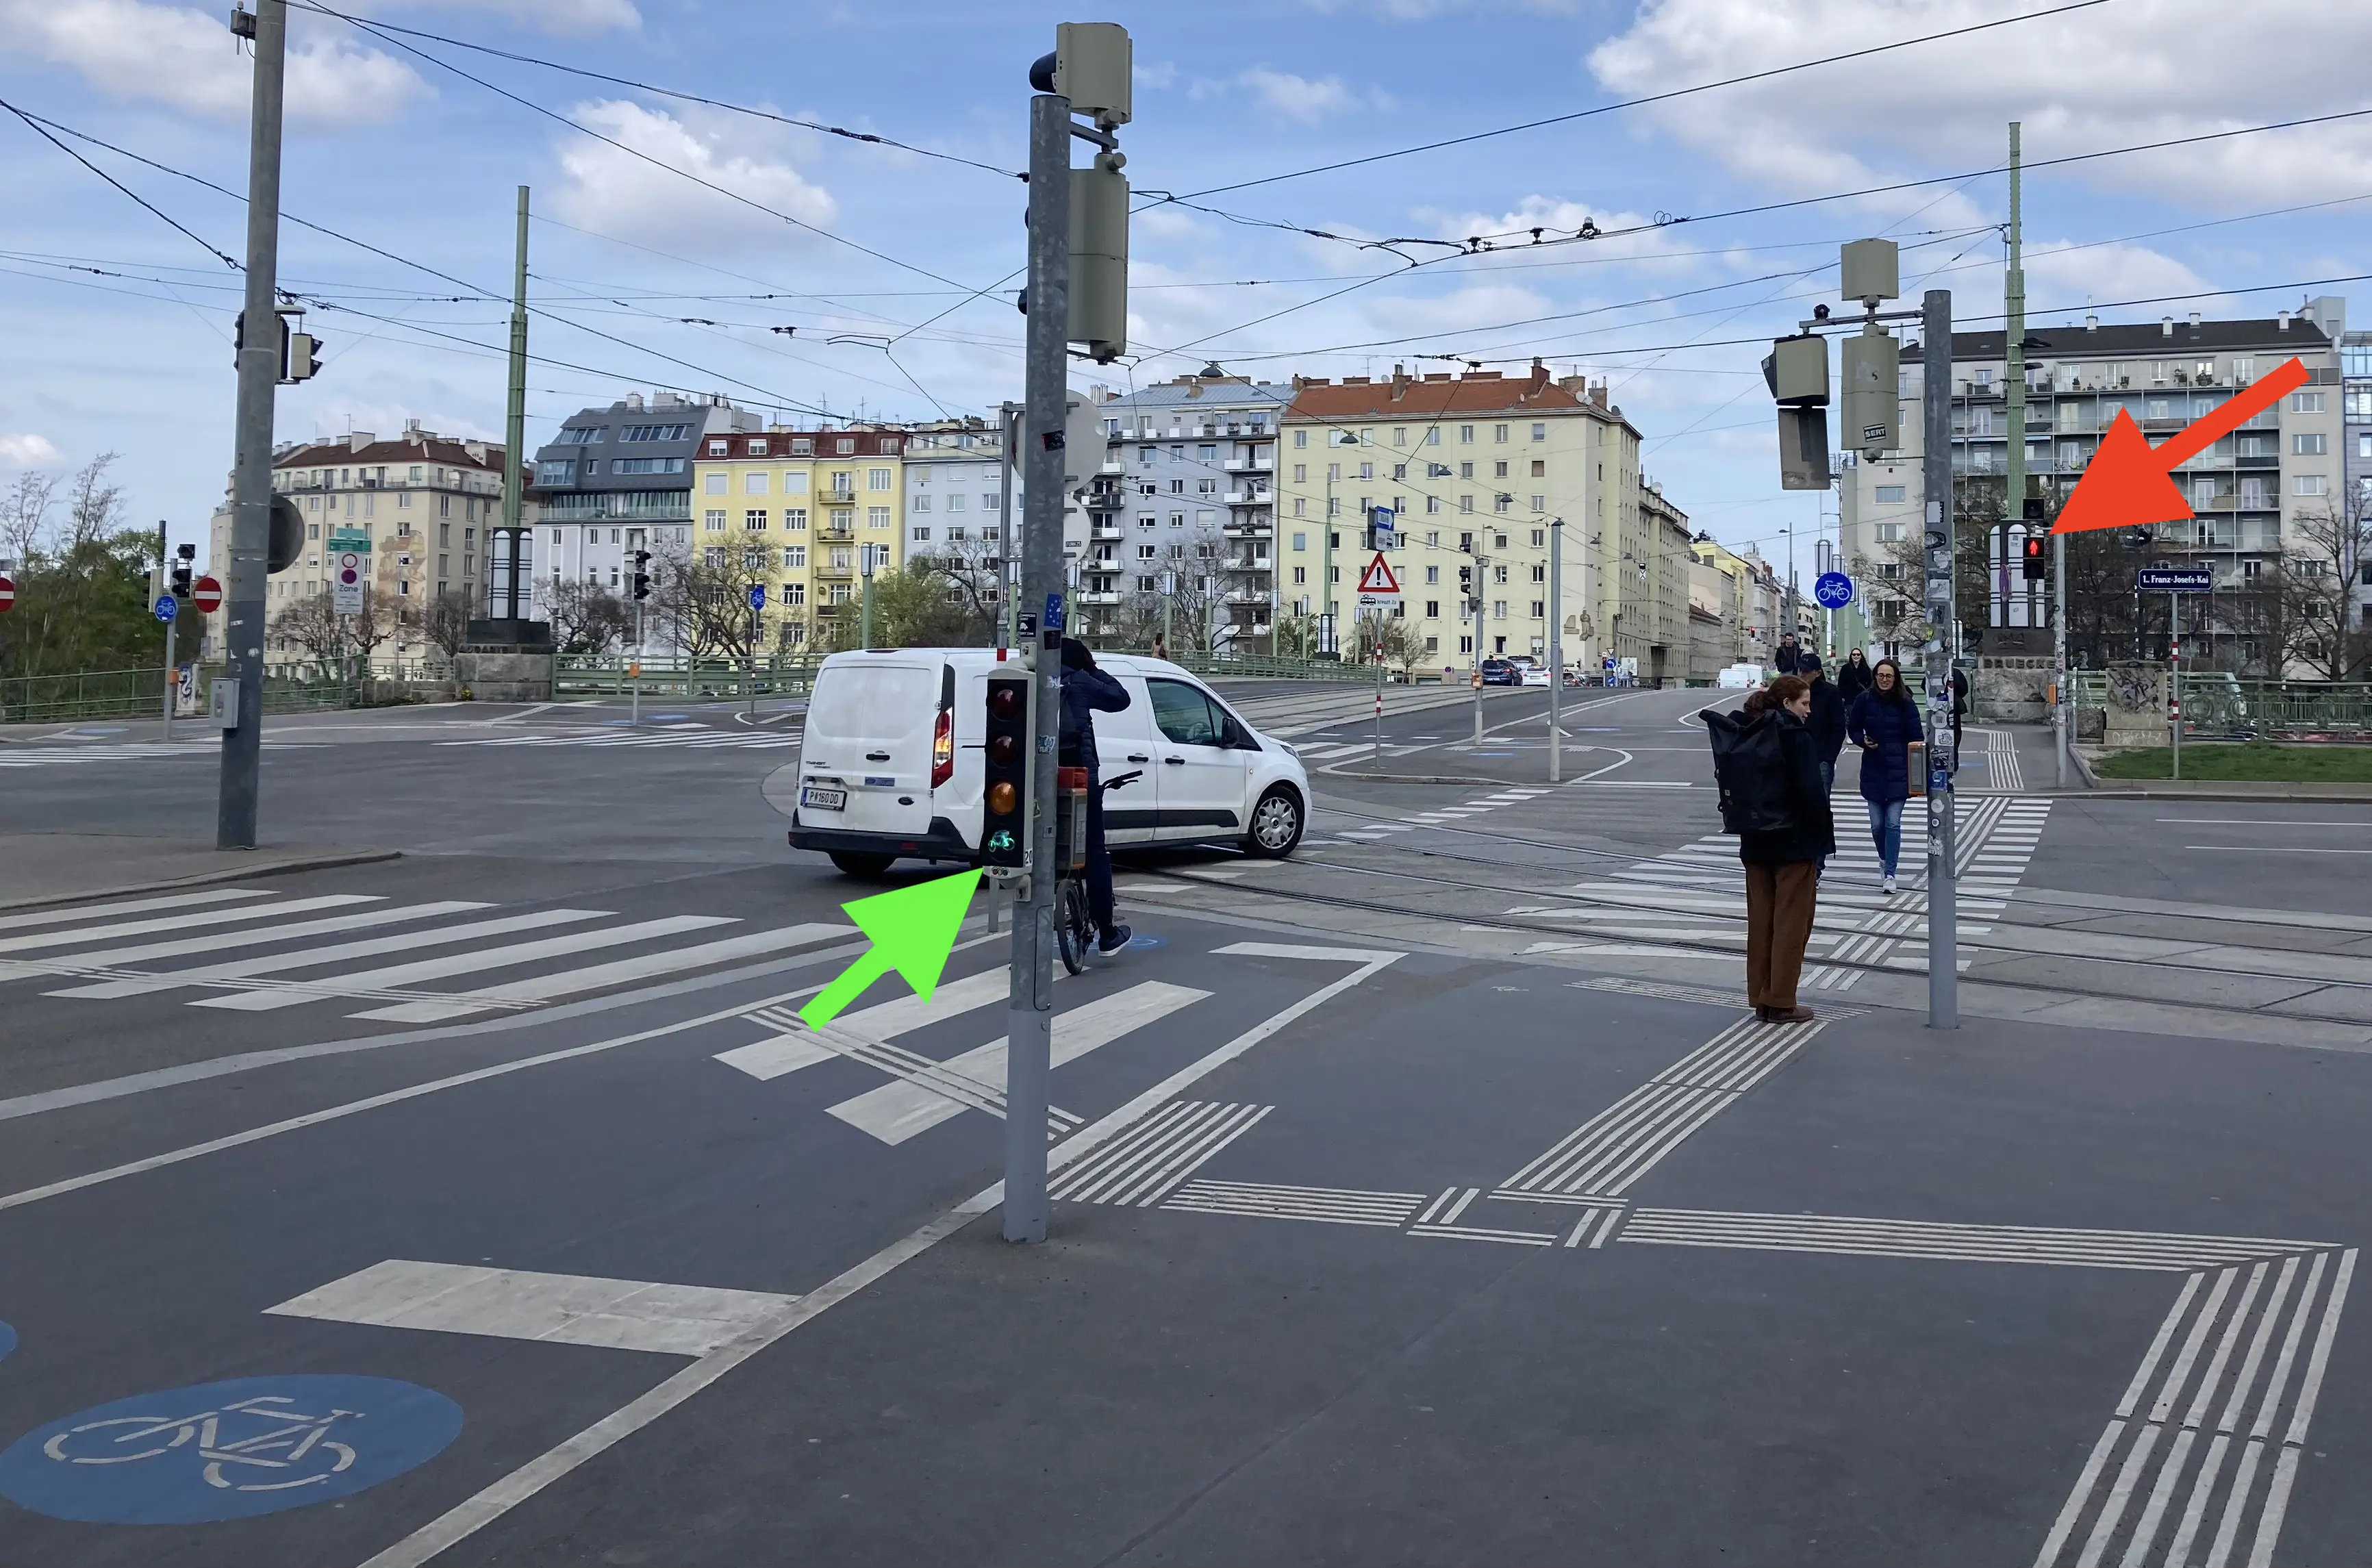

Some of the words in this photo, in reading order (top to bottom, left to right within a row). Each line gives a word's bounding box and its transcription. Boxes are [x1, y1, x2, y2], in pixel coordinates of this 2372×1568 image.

[1865, 428, 1885, 438] SERT
[2143, 574, 2150, 583] 1.
[2151, 575, 2209, 583] Franz-Josefs-Kai
[338, 584, 358, 592] Zone
[1984, 659, 2056, 669] BRUECKE
[1024, 850, 1033, 864] 20
